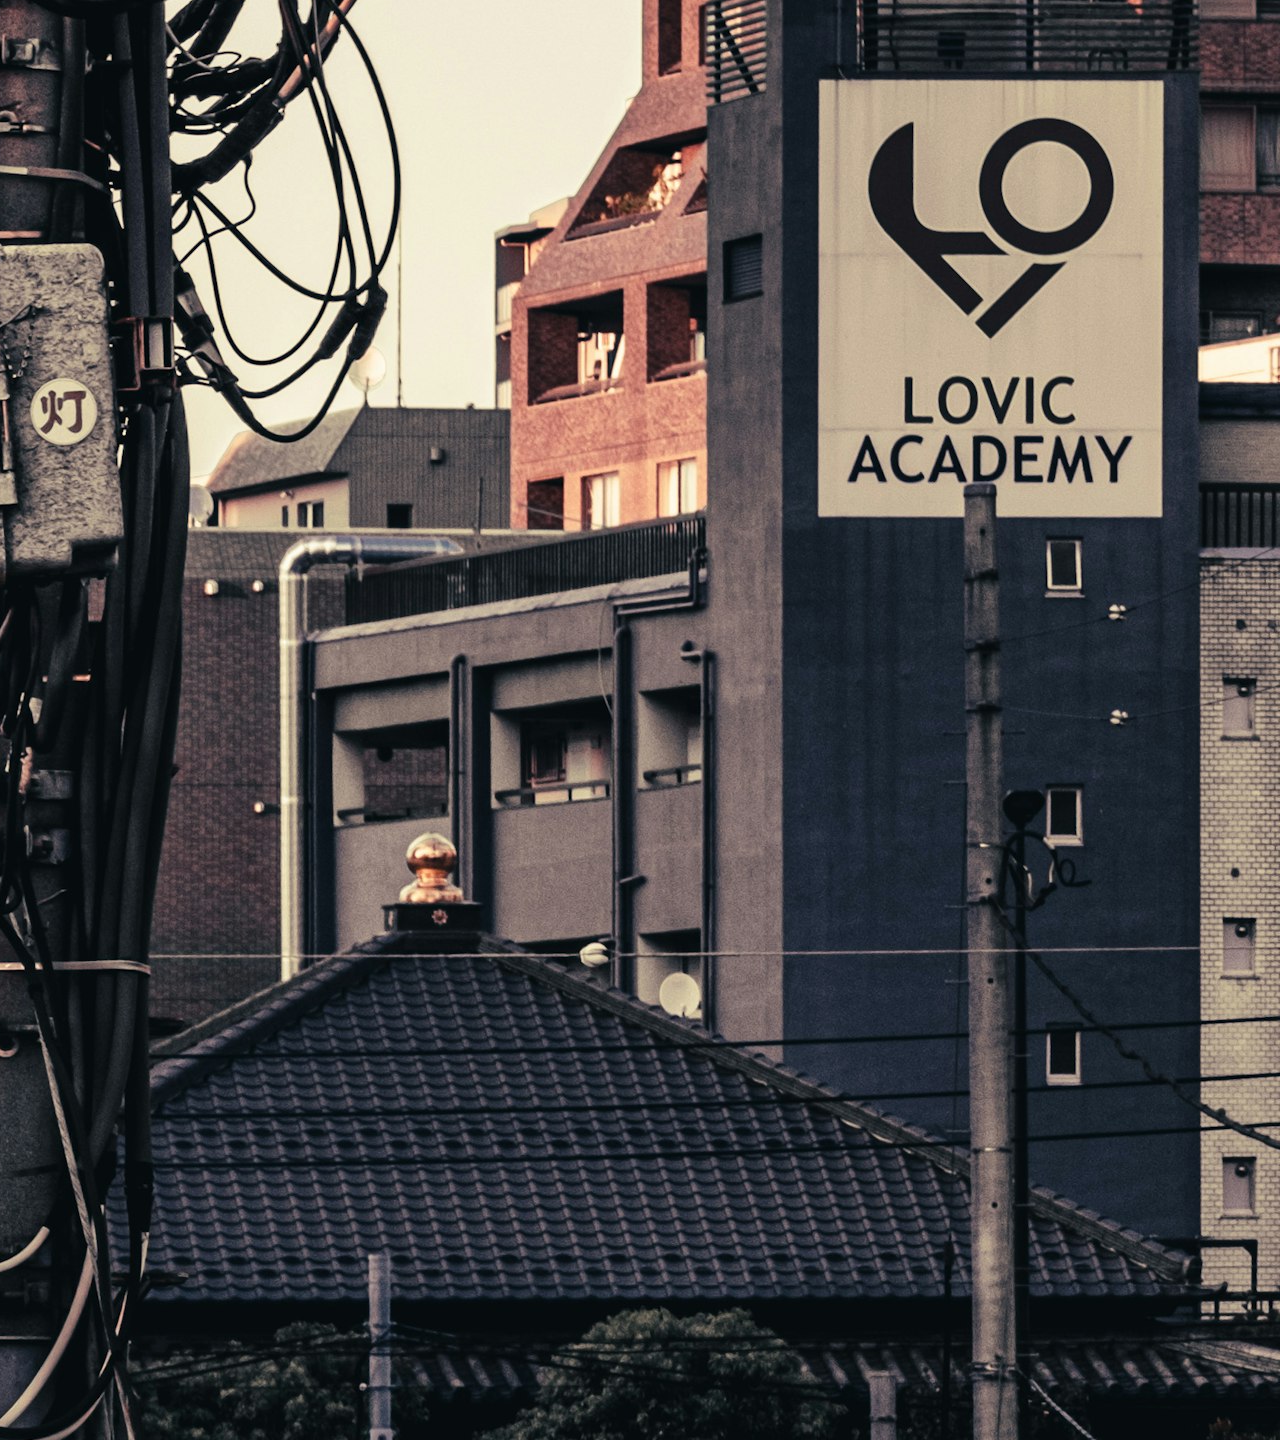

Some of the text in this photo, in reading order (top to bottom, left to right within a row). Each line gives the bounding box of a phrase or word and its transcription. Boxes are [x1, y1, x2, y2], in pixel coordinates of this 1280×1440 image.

[40, 388, 88, 437] 灯
[904, 376, 1076, 426] LOVIC
[848, 434, 1132, 484] ACADEMY
